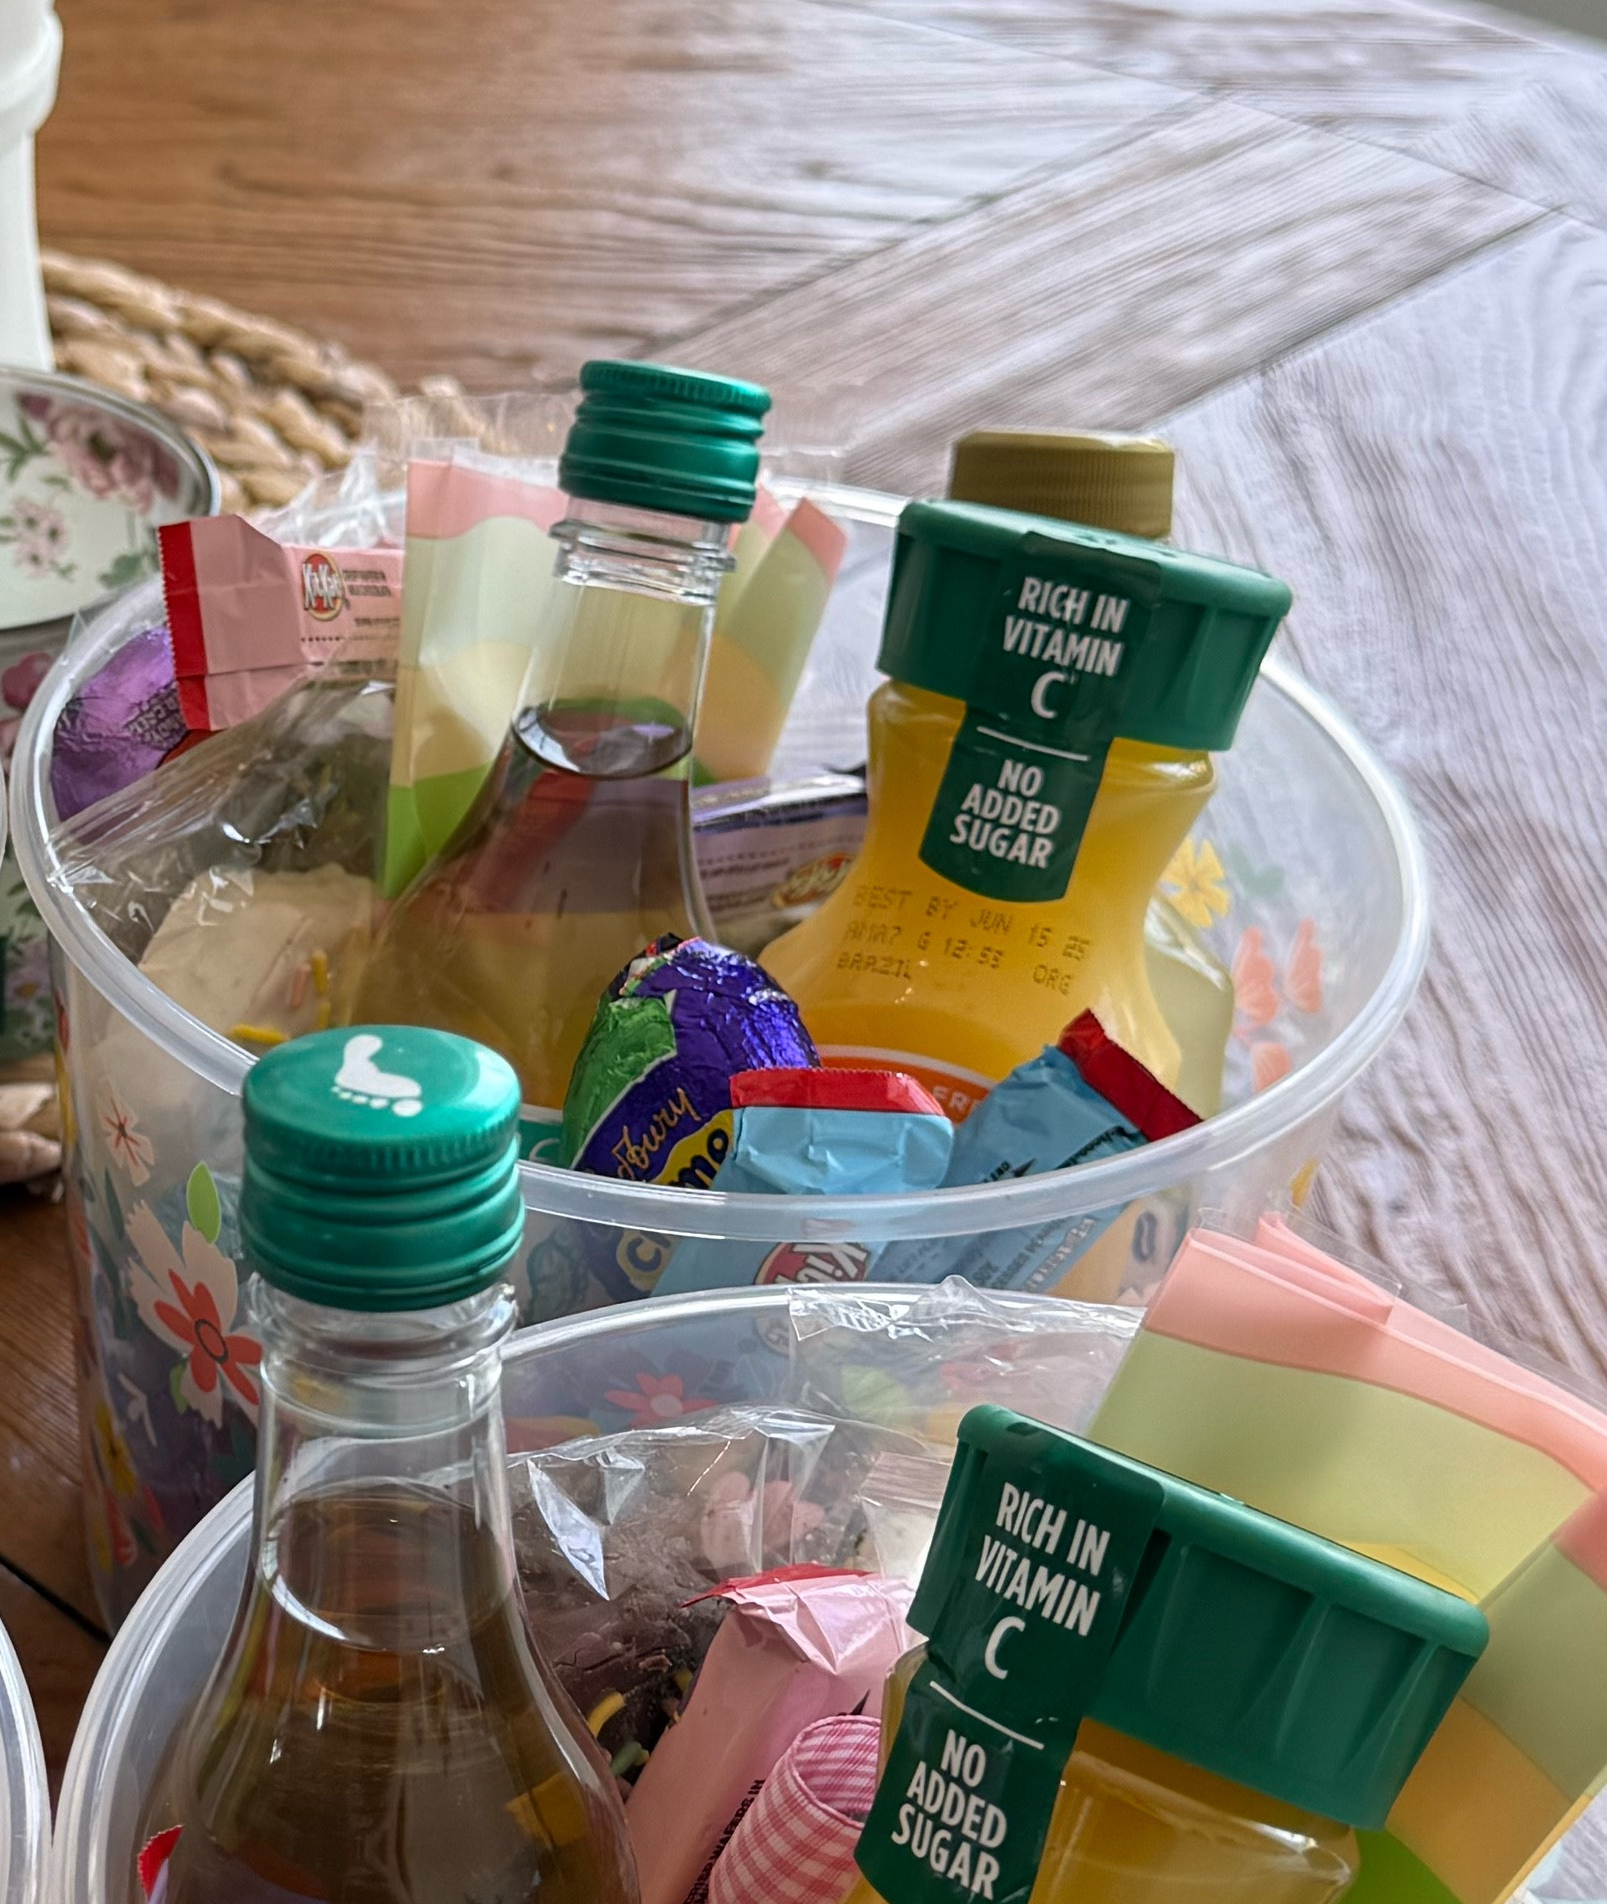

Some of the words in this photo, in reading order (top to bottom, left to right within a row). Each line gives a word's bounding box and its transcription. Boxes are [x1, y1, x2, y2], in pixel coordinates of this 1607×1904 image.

[1017, 576, 1092, 625] RICH
[1090, 594, 1130, 633] IN
[1003, 615, 1124, 677] VITAMIN
[1031, 670, 1067, 719] C
[997, 758, 1043, 797] NO
[961, 783, 1062, 835] ADDED
[950, 813, 1055, 870] SUGAR
[995, 1482, 1068, 1555] RICH
[1067, 1519, 1111, 1576] IN
[975, 1534, 1102, 1637] VITAMIN
[984, 1615, 1025, 1680] C
[941, 1728, 986, 1789] NO
[906, 1761, 1008, 1850] ADDED
[891, 1802, 1001, 1901] SUGAR
